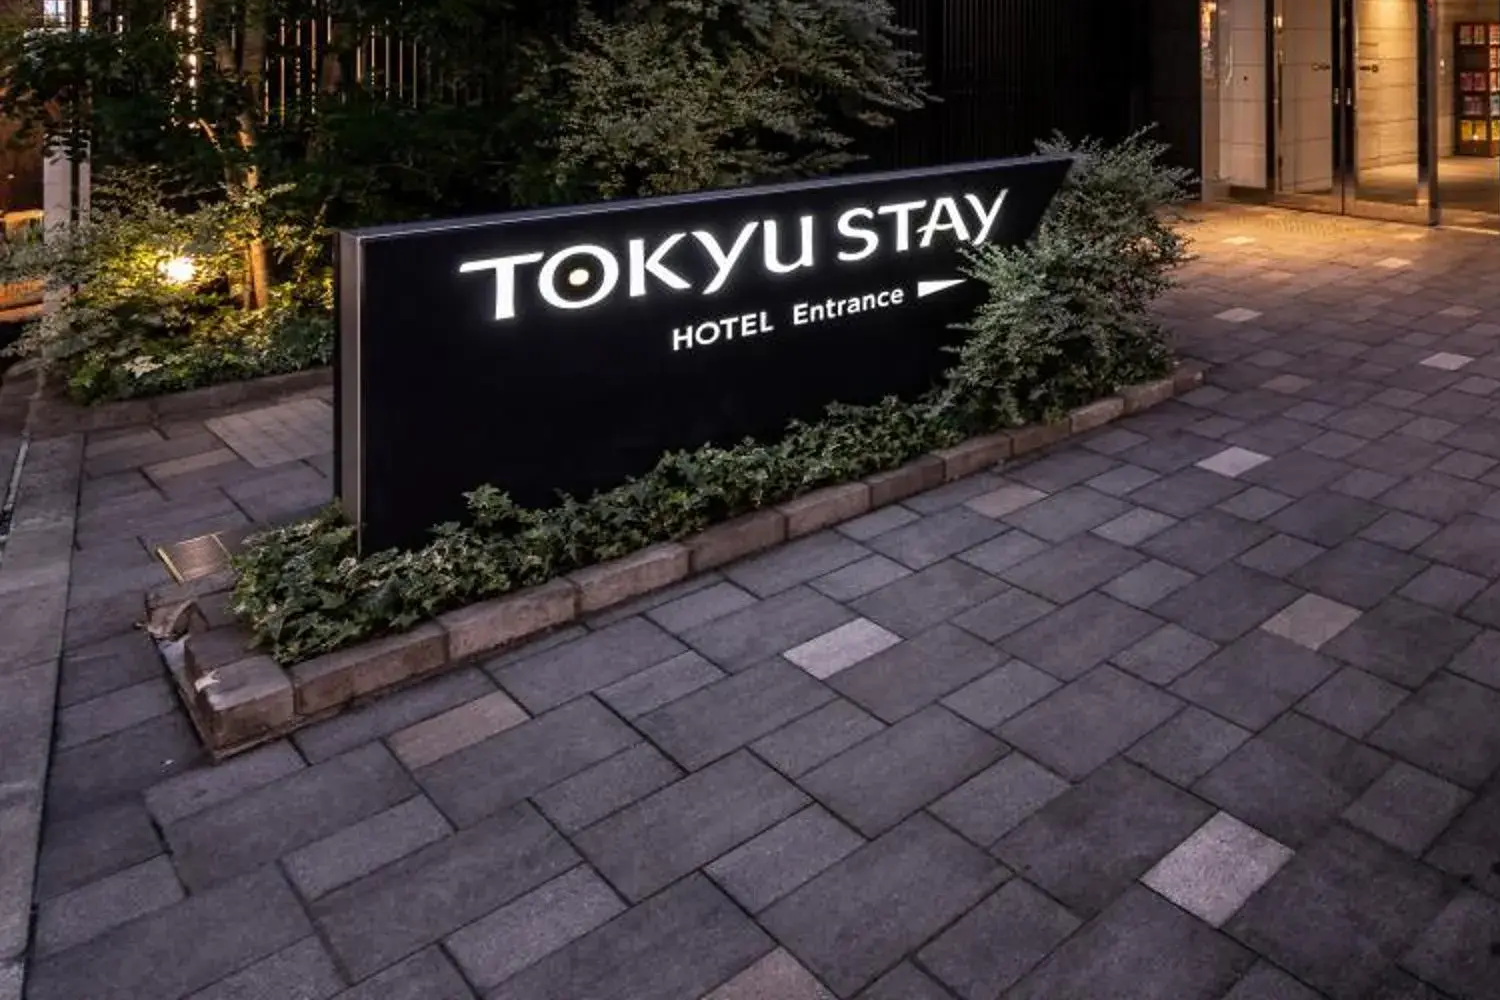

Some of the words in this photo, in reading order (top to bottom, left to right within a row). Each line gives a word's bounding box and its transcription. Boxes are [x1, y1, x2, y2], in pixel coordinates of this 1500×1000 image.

[458, 215, 814, 320] TOKYU
[837, 188, 1008, 262] STAY
[672, 311, 774, 351] HOTEL
[793, 287, 905, 326] Entrance
